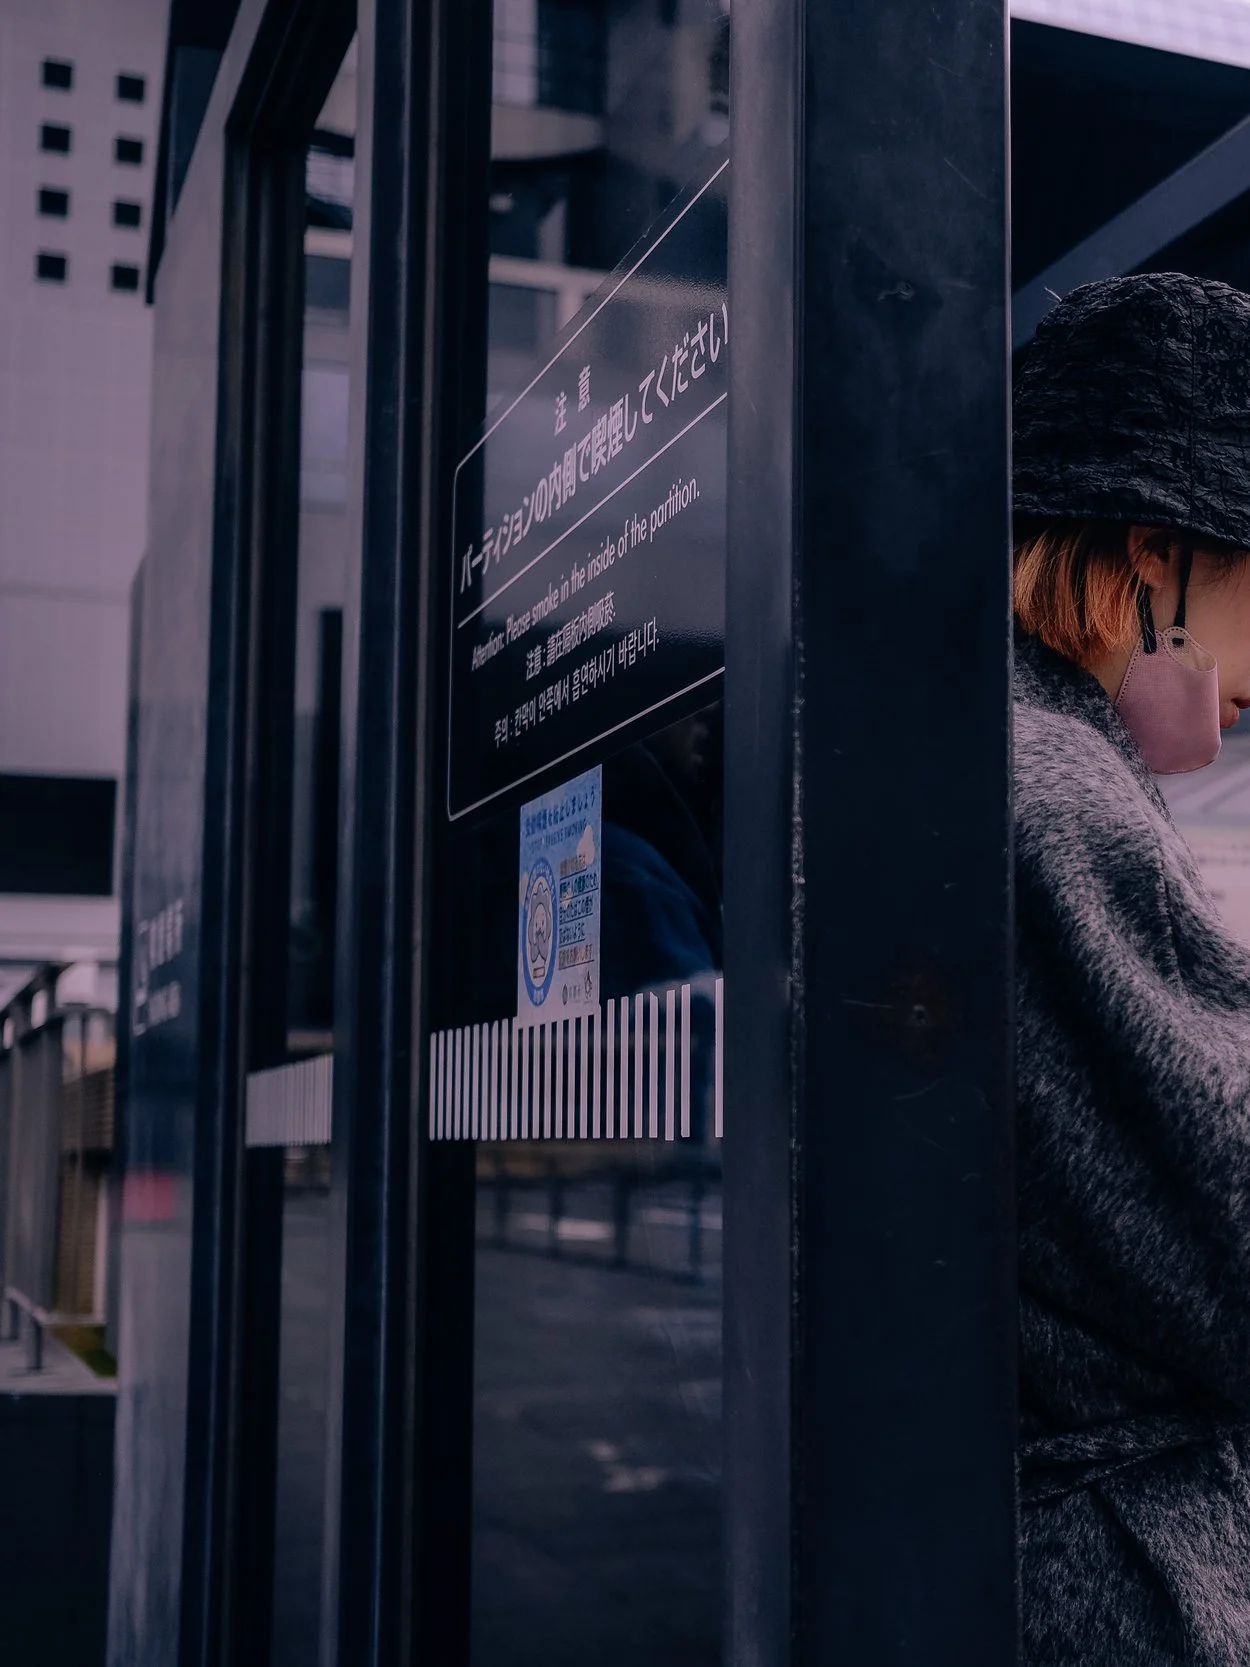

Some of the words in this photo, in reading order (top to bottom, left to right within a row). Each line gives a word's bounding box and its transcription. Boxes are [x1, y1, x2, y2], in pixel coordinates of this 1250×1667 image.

[460, 303, 728, 593] パーティションの内側で喫煙してください
[554, 364, 592, 436] 注意
[471, 631, 505, 671] Attention:
[506, 613, 531, 645] Please
[532, 583, 559, 626] smoke
[560, 574, 569, 603] in
[571, 562, 586, 597] the
[588, 536, 616, 583] inside
[616, 519, 630, 558] of
[630, 513, 648, 549] the
[649, 478, 700, 543] partition.
[494, 715, 509, 748] 주의
[514, 697, 537, 737] 칸막이
[538, 674, 570, 722] 안쪽에서
[571, 644, 616, 702] 흡연하시기
[618, 616, 660, 671] 바랍니다.
